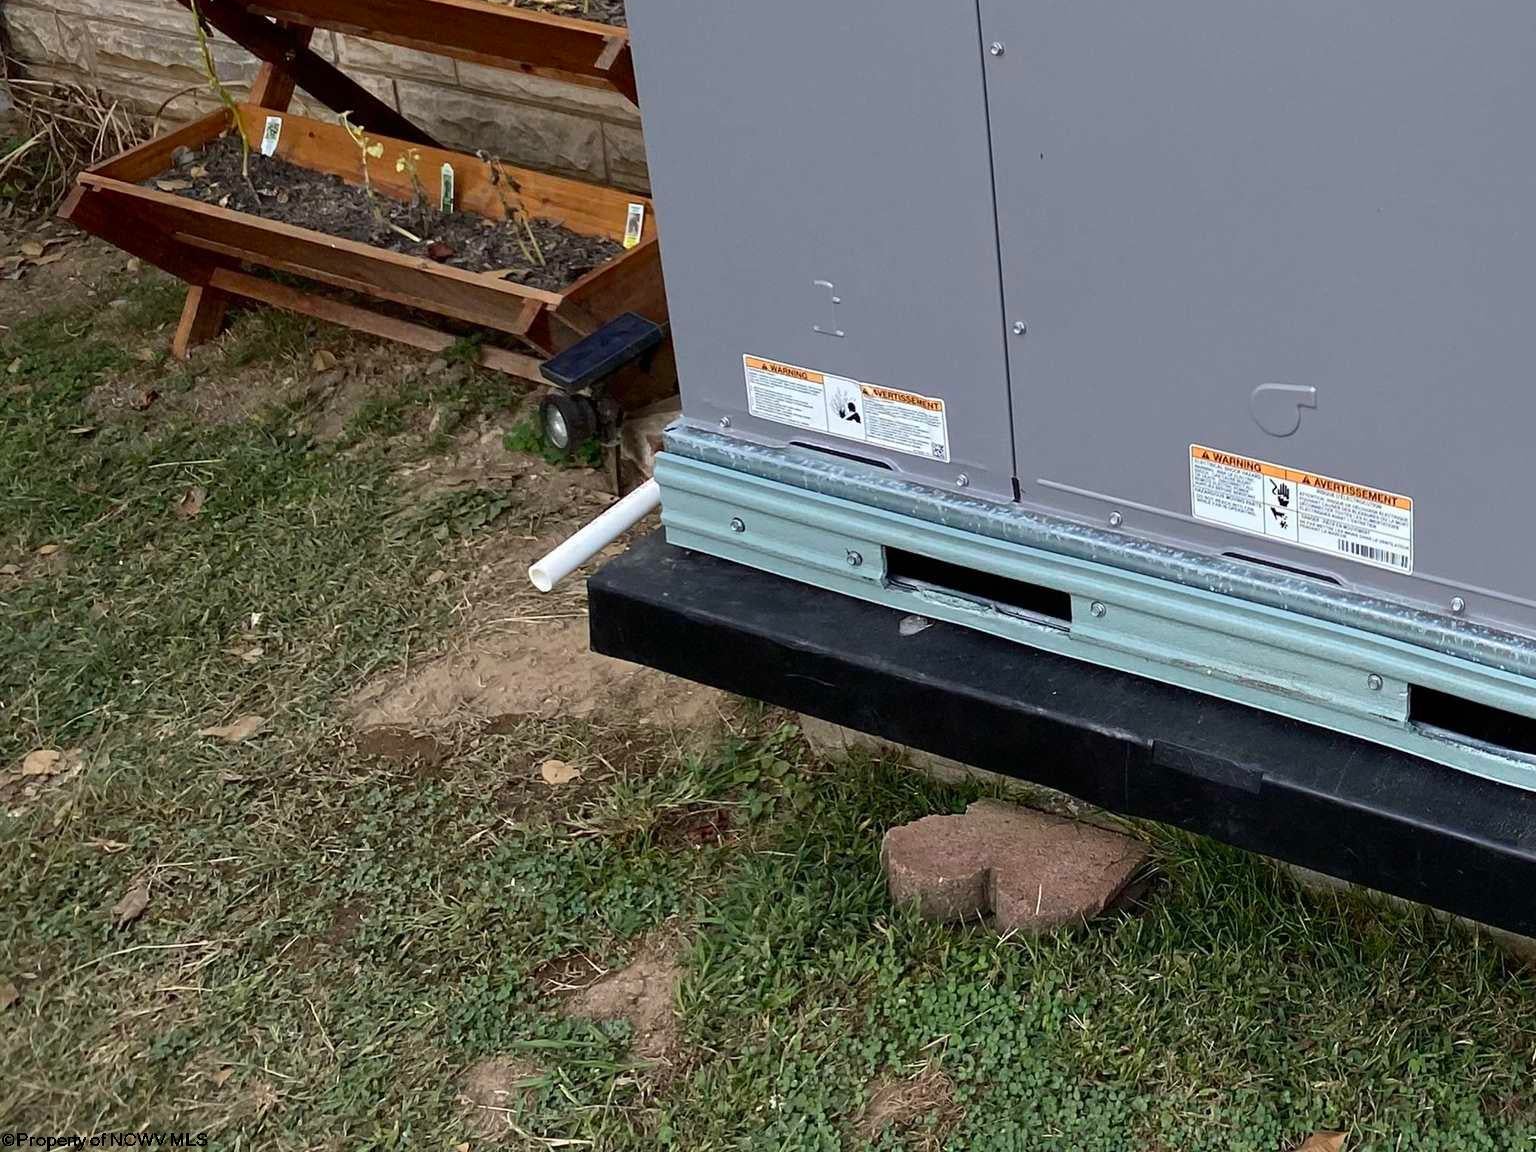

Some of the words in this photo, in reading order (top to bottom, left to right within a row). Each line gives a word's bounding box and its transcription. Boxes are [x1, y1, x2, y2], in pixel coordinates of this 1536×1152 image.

[769, 364, 807, 379] WARNING
[873, 388, 939, 410] AVERTISSEMENT
[1213, 452, 1261, 472] WARNING
[1313, 477, 1397, 506] AVERTISSEMENT
